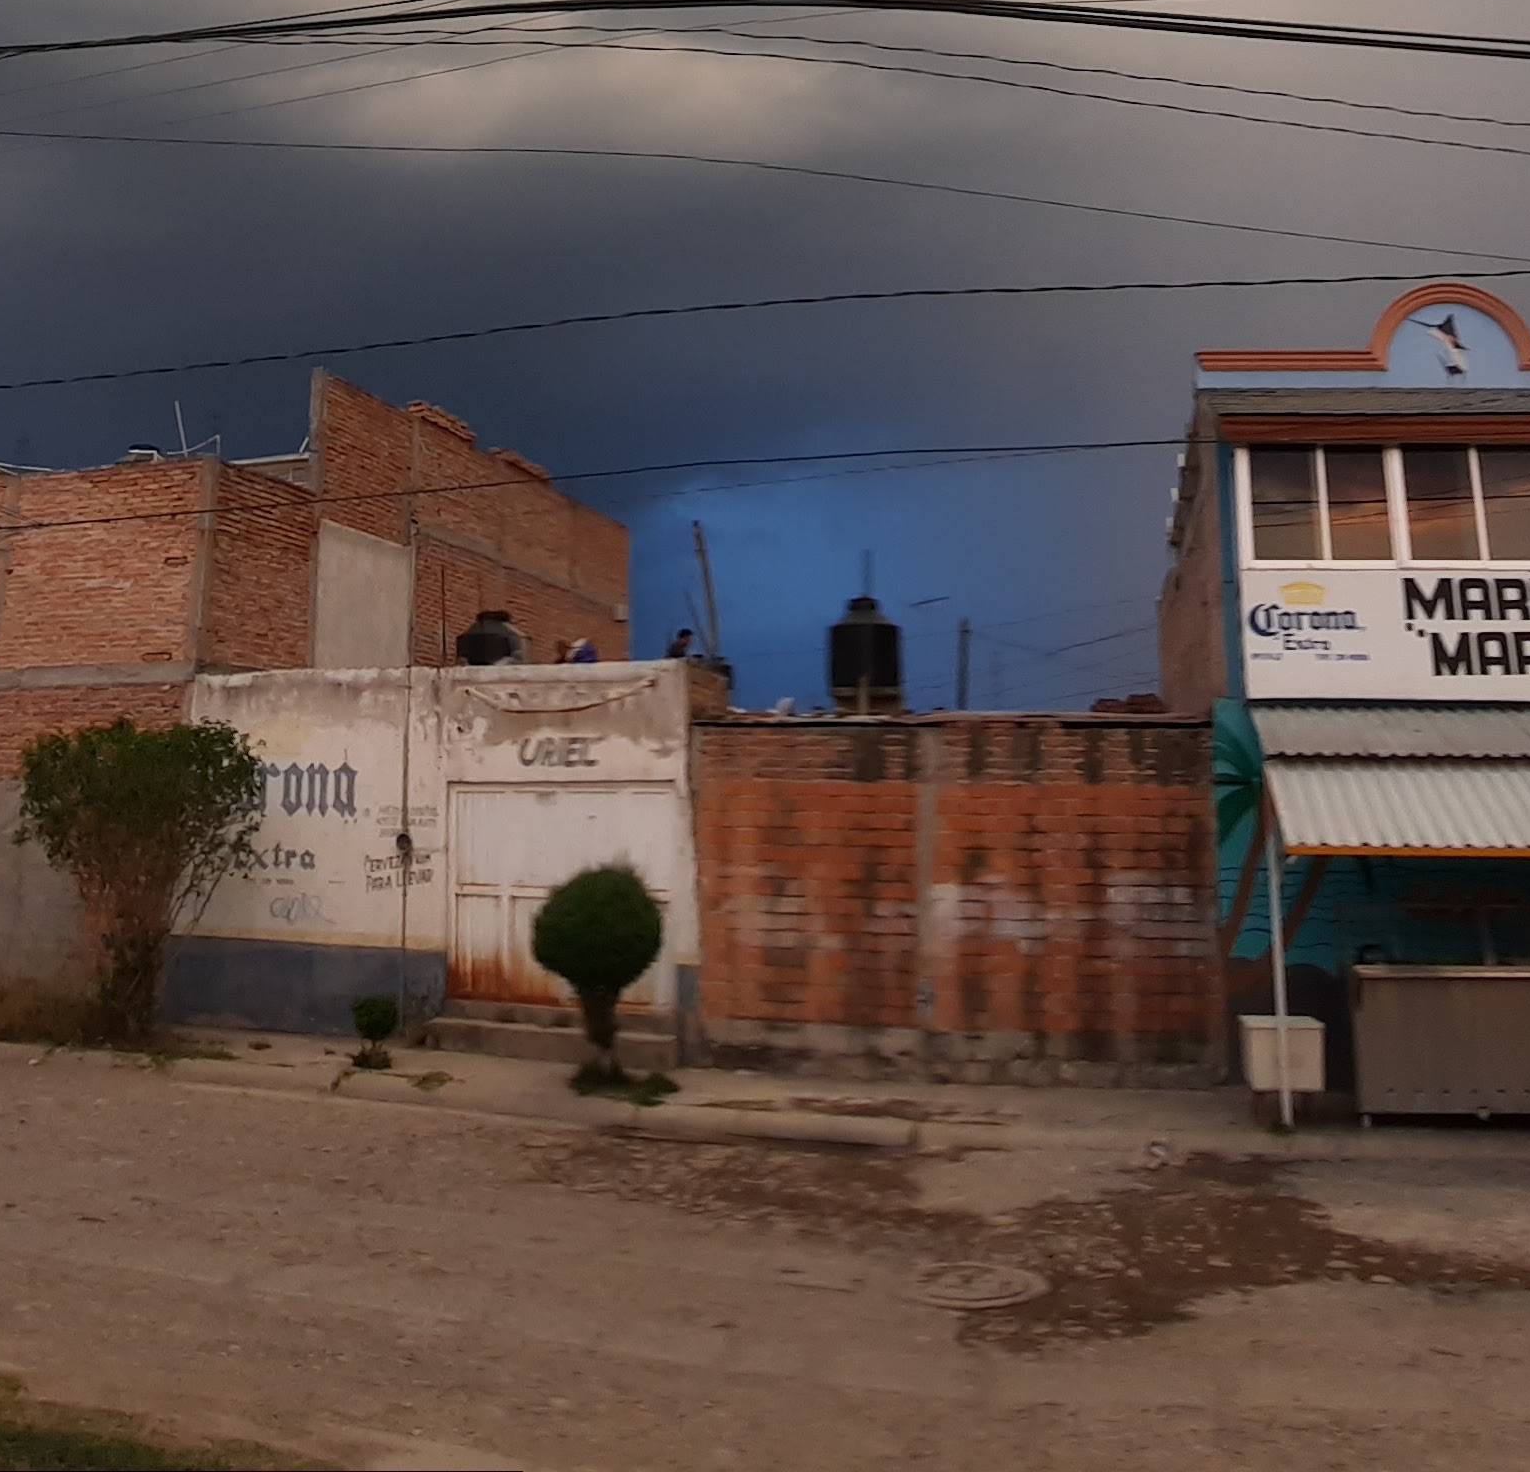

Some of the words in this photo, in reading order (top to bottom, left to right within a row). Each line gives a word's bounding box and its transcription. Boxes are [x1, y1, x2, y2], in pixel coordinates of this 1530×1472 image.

[1248, 603, 1357, 637] Corona
[1282, 633, 1332, 650] Extra
[255, 762, 358, 818] rona
